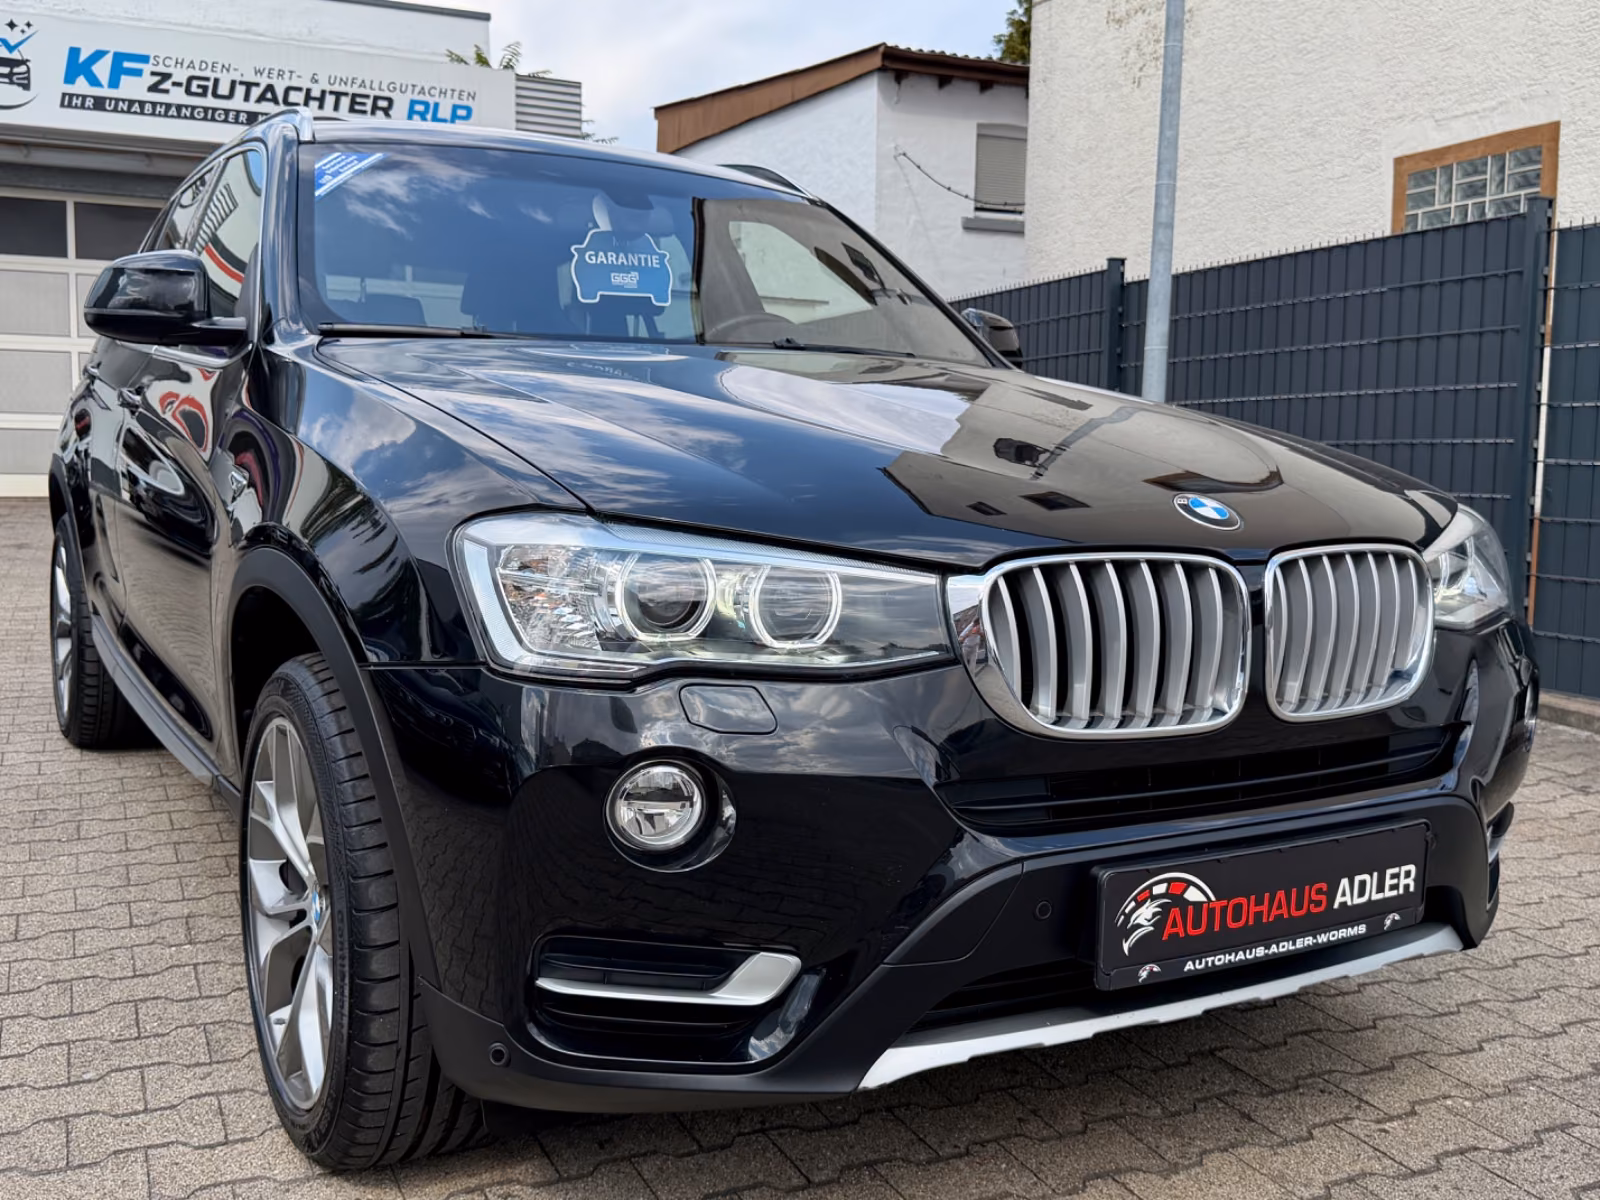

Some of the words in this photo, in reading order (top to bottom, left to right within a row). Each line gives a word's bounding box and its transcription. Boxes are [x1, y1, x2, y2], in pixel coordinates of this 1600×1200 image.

[152, 55, 244, 77] SCHADEN-,
[253, 66, 303, 82] WERT-
[310, 73, 320, 85] &
[327, 75, 477, 101] UNFALLGUTACHTEN
[63, 96, 95, 109] IHR
[407, 99, 473, 123] RLP
[585, 251, 660, 268] GARANTIE
[1162, 882, 1328, 940] AUTOHAUS
[1333, 864, 1417, 909] ADLER
[1183, 924, 1367, 973] AUTOHAUS-ADLER-WORMS
